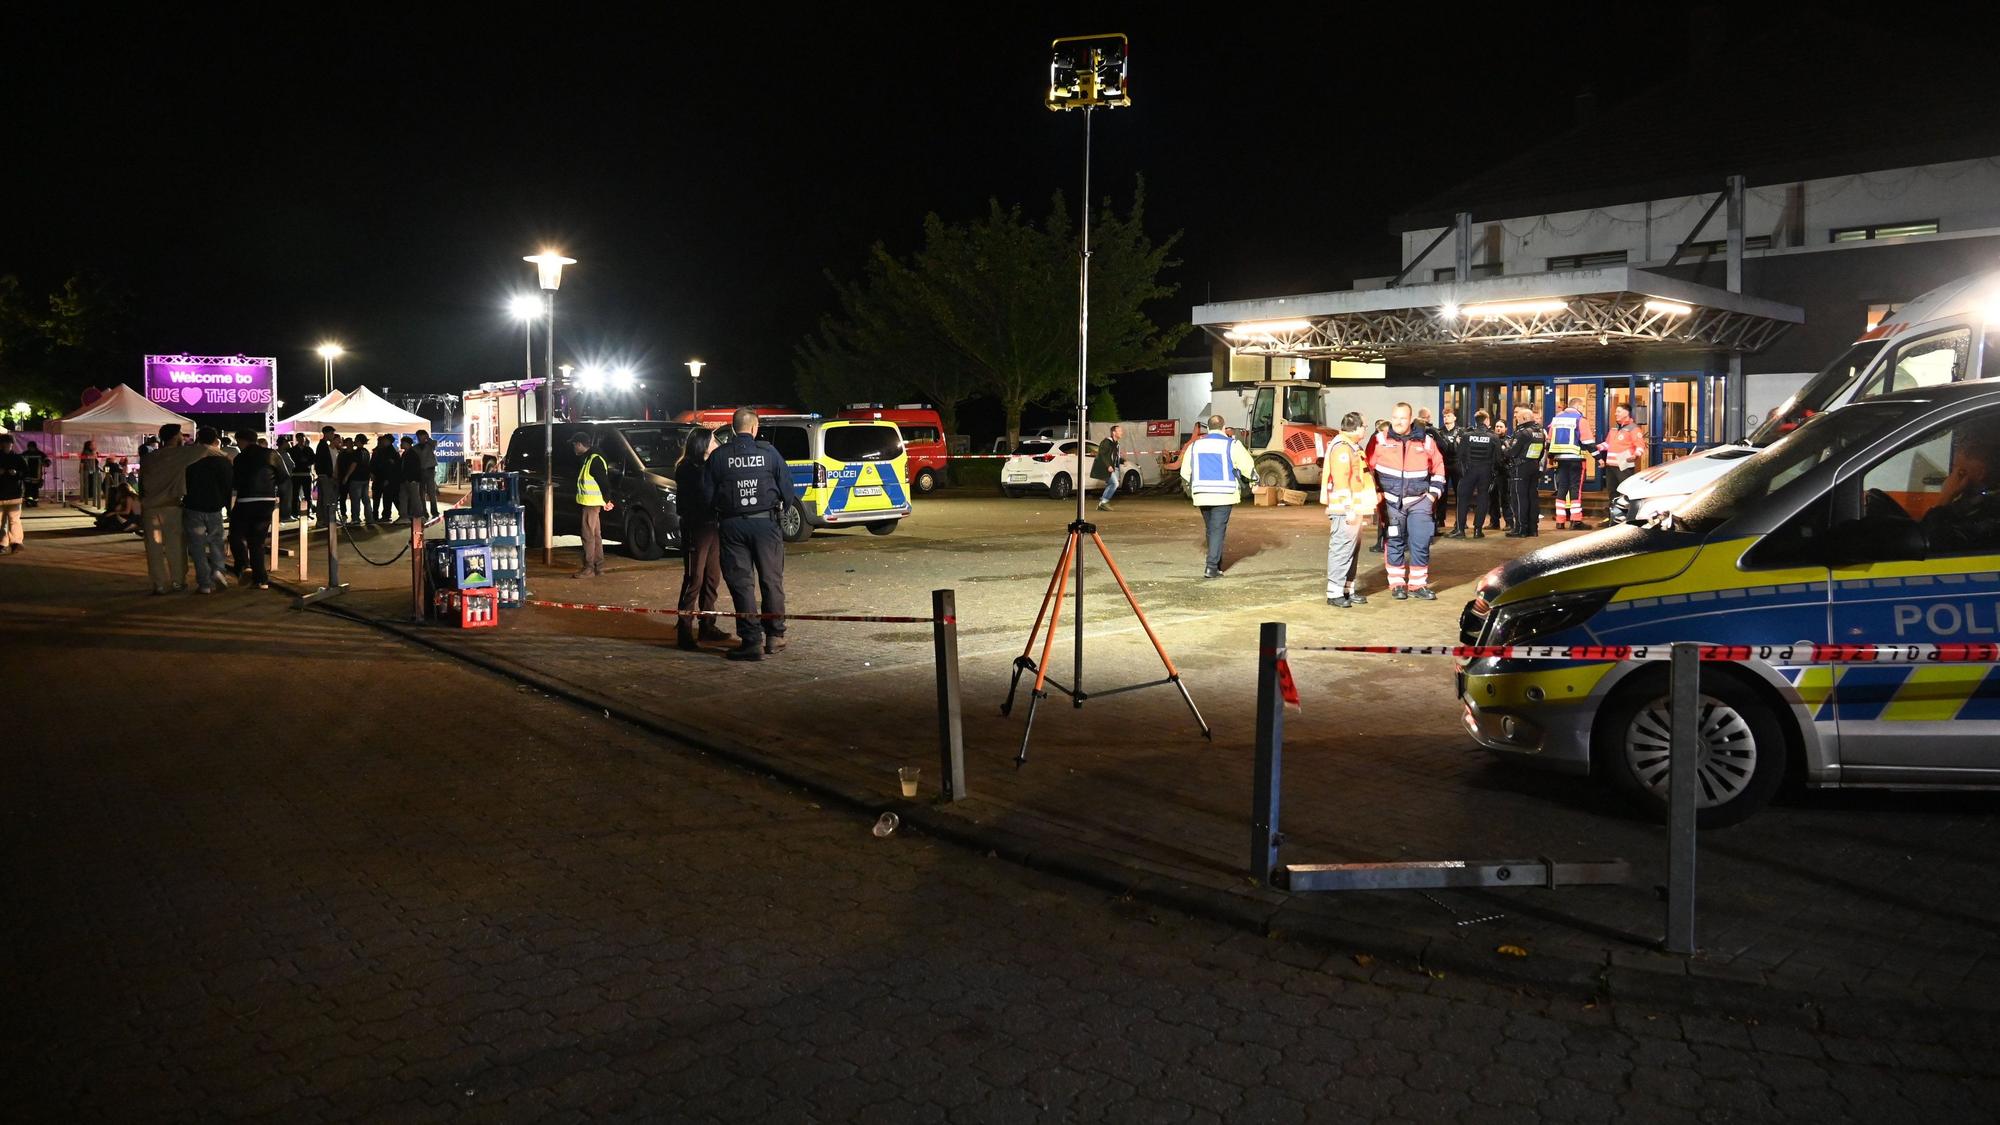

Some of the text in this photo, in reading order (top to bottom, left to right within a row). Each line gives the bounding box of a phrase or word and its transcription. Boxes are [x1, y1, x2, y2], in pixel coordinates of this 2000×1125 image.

[169, 371, 253, 384] Welcome to
[151, 388, 180, 403] WE
[204, 389, 236, 403] THE
[1469, 435, 1490, 443] POLIZEI
[728, 455, 765, 468] POLIZEI
[828, 470, 857, 478] POLIZEI
[737, 479, 758, 488] NRW
[740, 488, 757, 497] DHF
[1527, 646, 1648, 658] POLIZEI
[1704, 645, 1794, 660] POLIZ
[1814, 645, 1942, 661] POLIZEI
